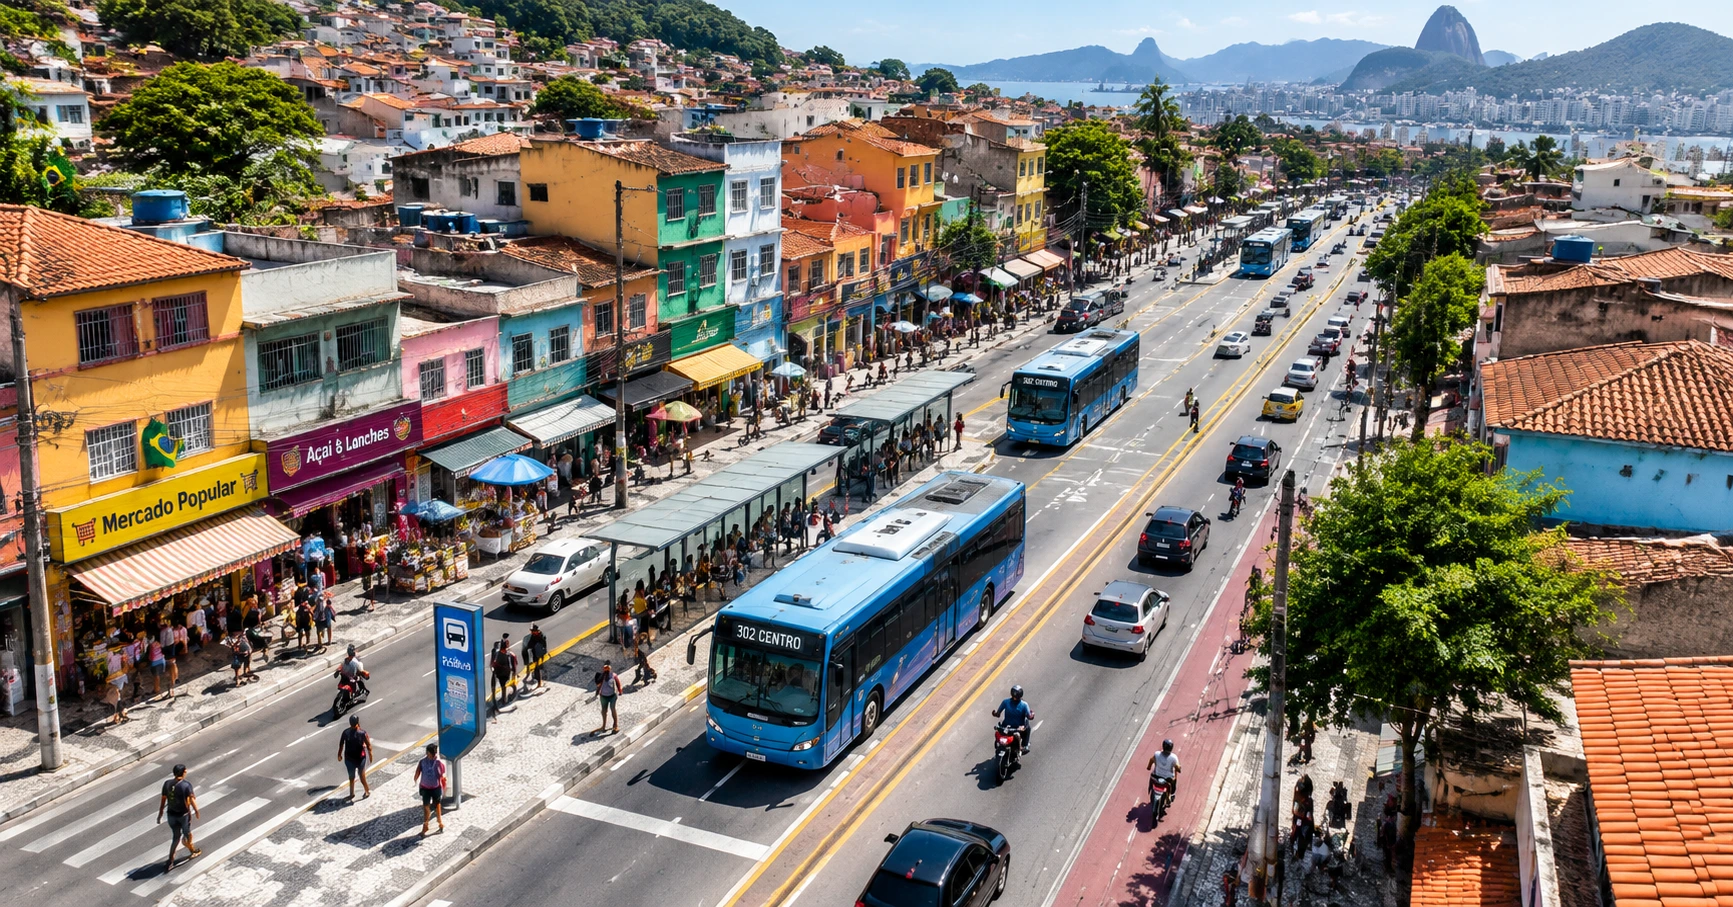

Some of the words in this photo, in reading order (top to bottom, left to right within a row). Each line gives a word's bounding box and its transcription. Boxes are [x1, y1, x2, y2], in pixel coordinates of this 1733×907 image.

[345, 427, 390, 452] Lanches
[102, 498, 174, 535] Mercado
[177, 480, 237, 511] Popular
[736, 624, 756, 641] 302
[758, 629, 801, 650] CENTRO
